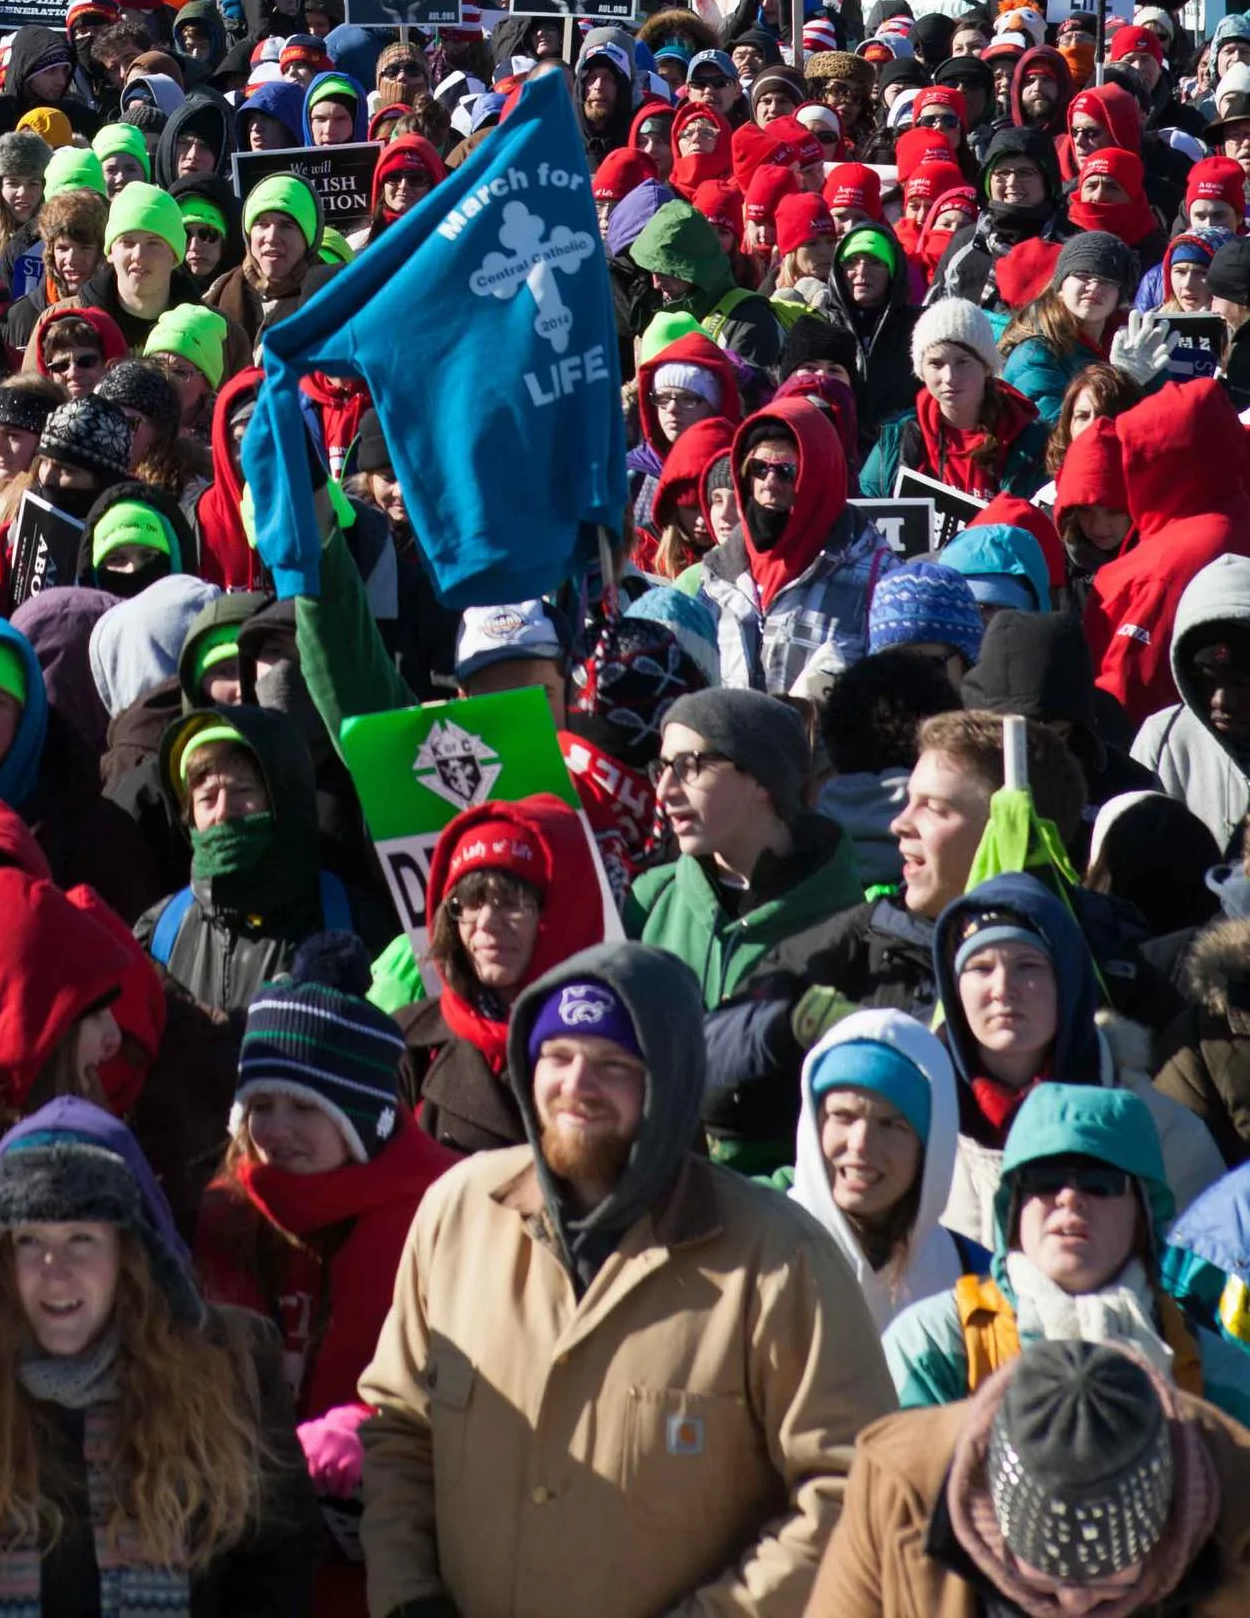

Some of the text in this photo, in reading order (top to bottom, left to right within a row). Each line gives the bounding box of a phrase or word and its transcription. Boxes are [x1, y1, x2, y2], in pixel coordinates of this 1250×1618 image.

[597, 3, 627, 15] AUL.ORG
[290, 159, 332, 178] We will
[311, 176, 357, 194] LISH
[322, 193, 368, 211] TION
[437, 162, 584, 241] March for
[476, 238, 588, 289] Central Catholic
[540, 313, 571, 333] 2014
[523, 344, 610, 408] LIFE
